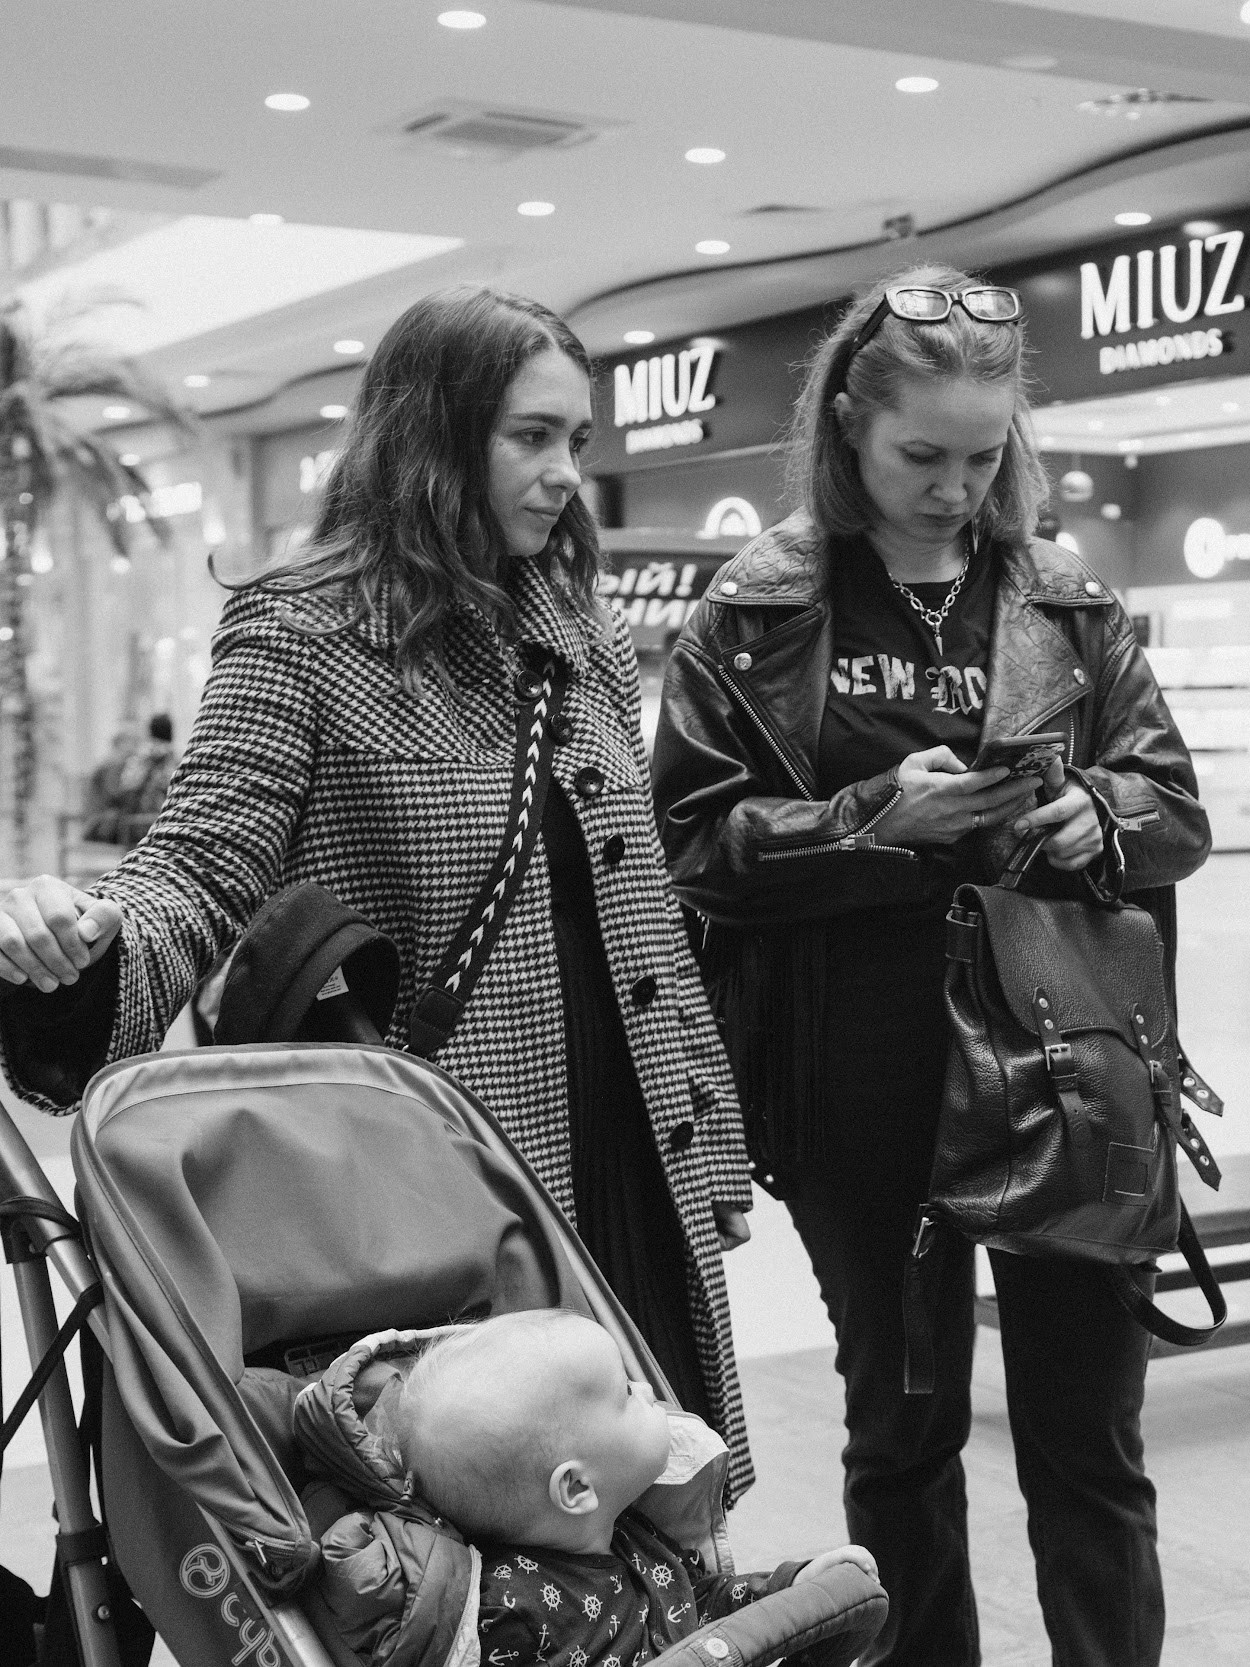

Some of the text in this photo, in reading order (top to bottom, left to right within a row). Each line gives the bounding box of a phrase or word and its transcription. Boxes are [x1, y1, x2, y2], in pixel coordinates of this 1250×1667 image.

[1080, 230, 1245, 339] MIUZ
[1099, 328, 1223, 375] DIAMONDS
[614, 346, 715, 427] MIUZ
[830, 653, 915, 700] NEW
